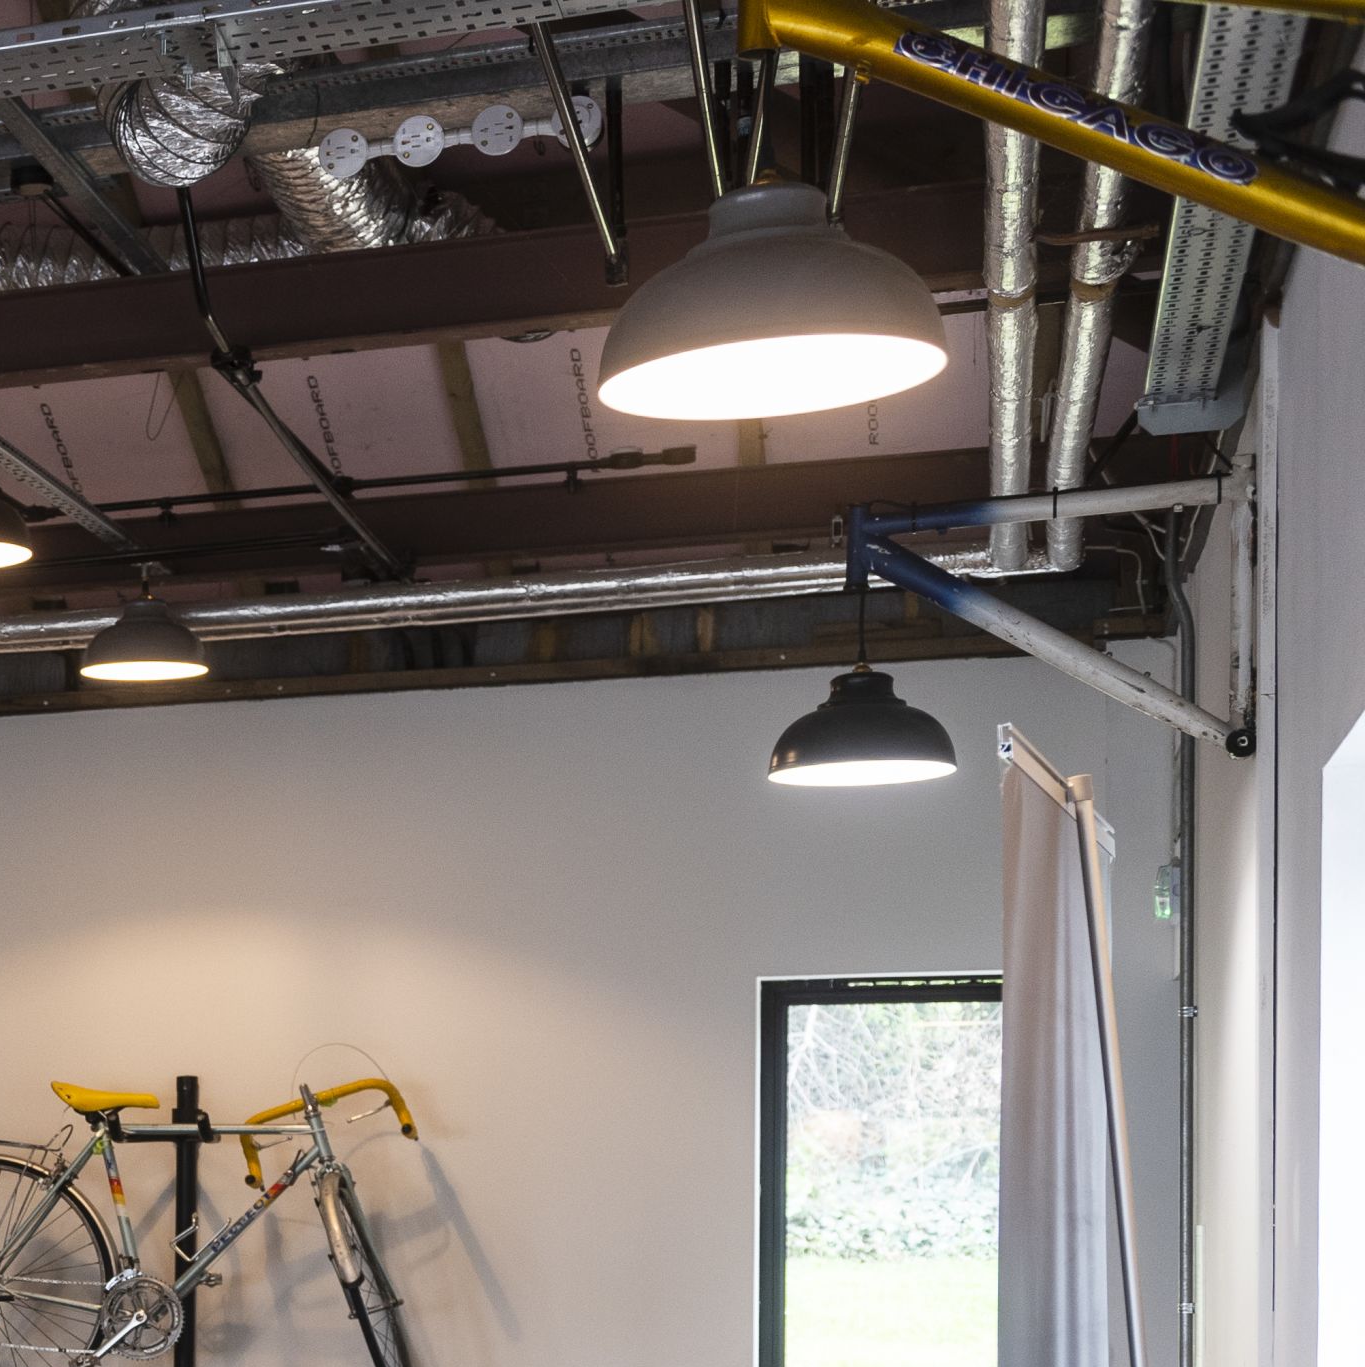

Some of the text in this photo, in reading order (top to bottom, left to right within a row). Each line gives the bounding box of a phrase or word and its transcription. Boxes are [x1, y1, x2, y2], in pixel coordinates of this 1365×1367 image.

[893, 31, 1259, 184] CHICAGO
[307, 375, 343, 477] OFBOARD
[570, 348, 600, 462] OOFBOARD
